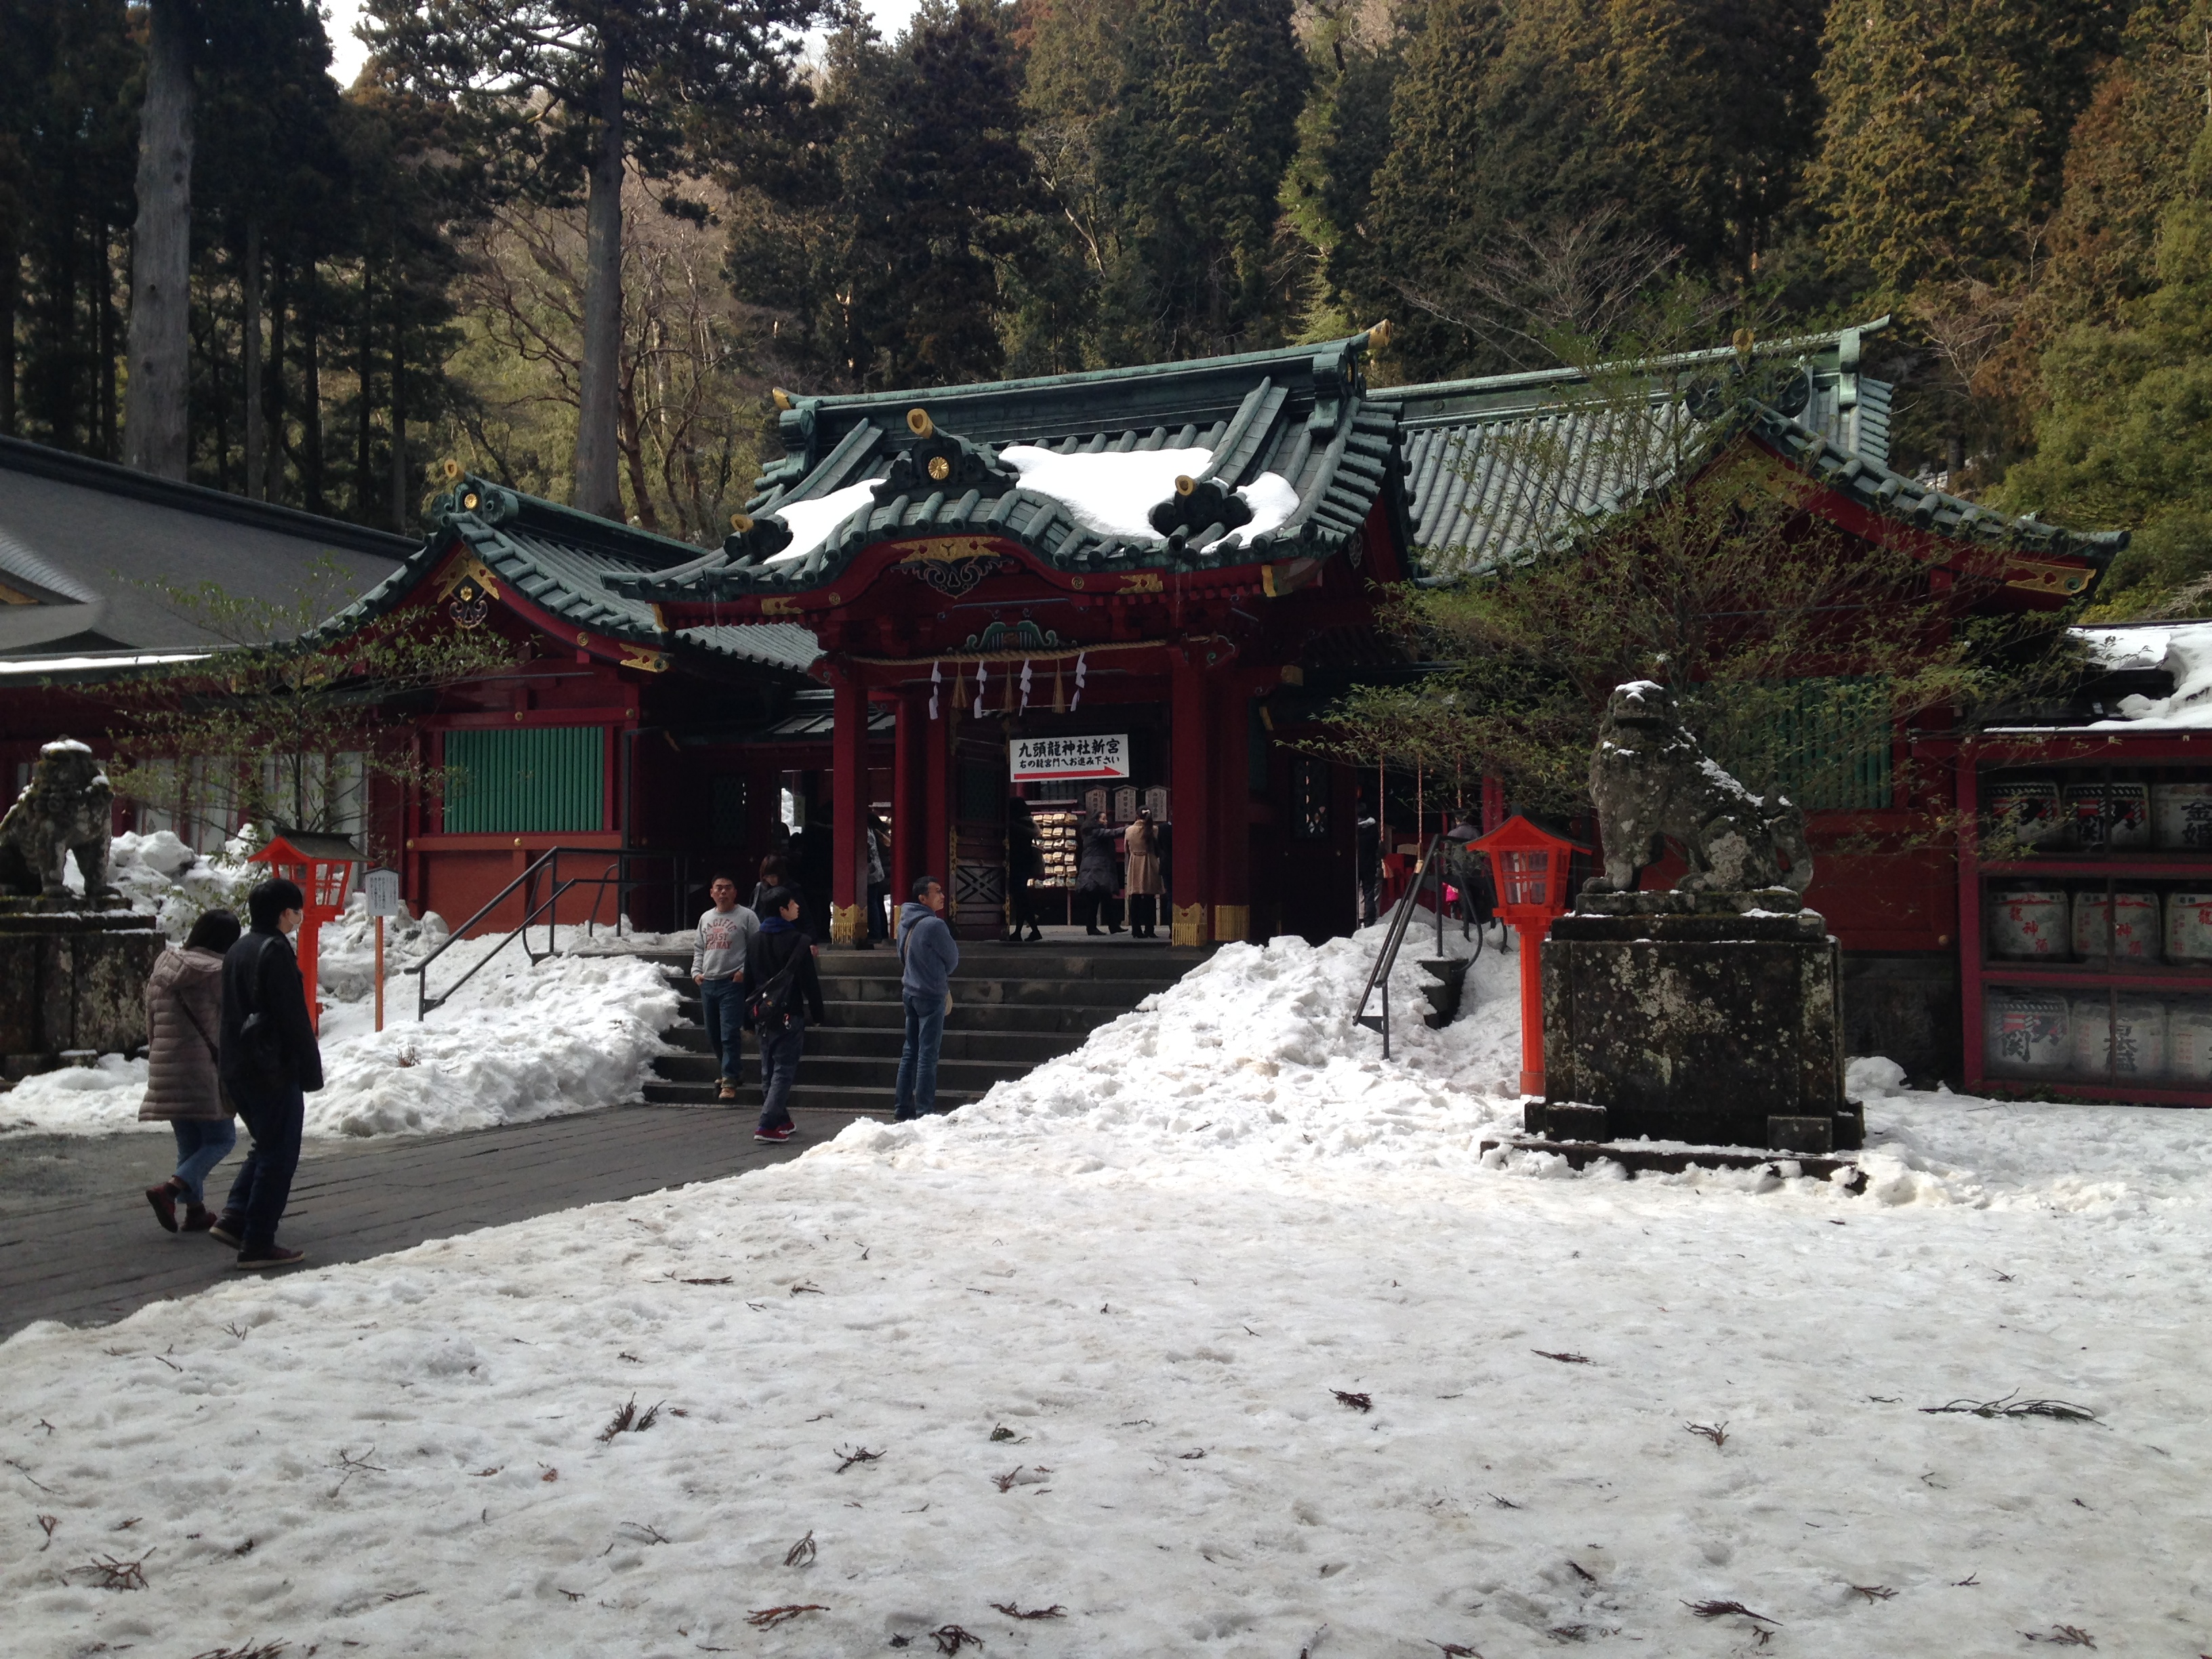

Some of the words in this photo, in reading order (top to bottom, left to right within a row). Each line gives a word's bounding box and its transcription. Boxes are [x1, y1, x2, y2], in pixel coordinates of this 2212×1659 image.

[1019, 738, 1120, 758] 九頭龍神社新宮
[1020, 756, 1120, 769] 右の龍宮門へお進み下さい
[702, 918, 737, 934] PACIFIC
[706, 933, 729, 941] COAST
